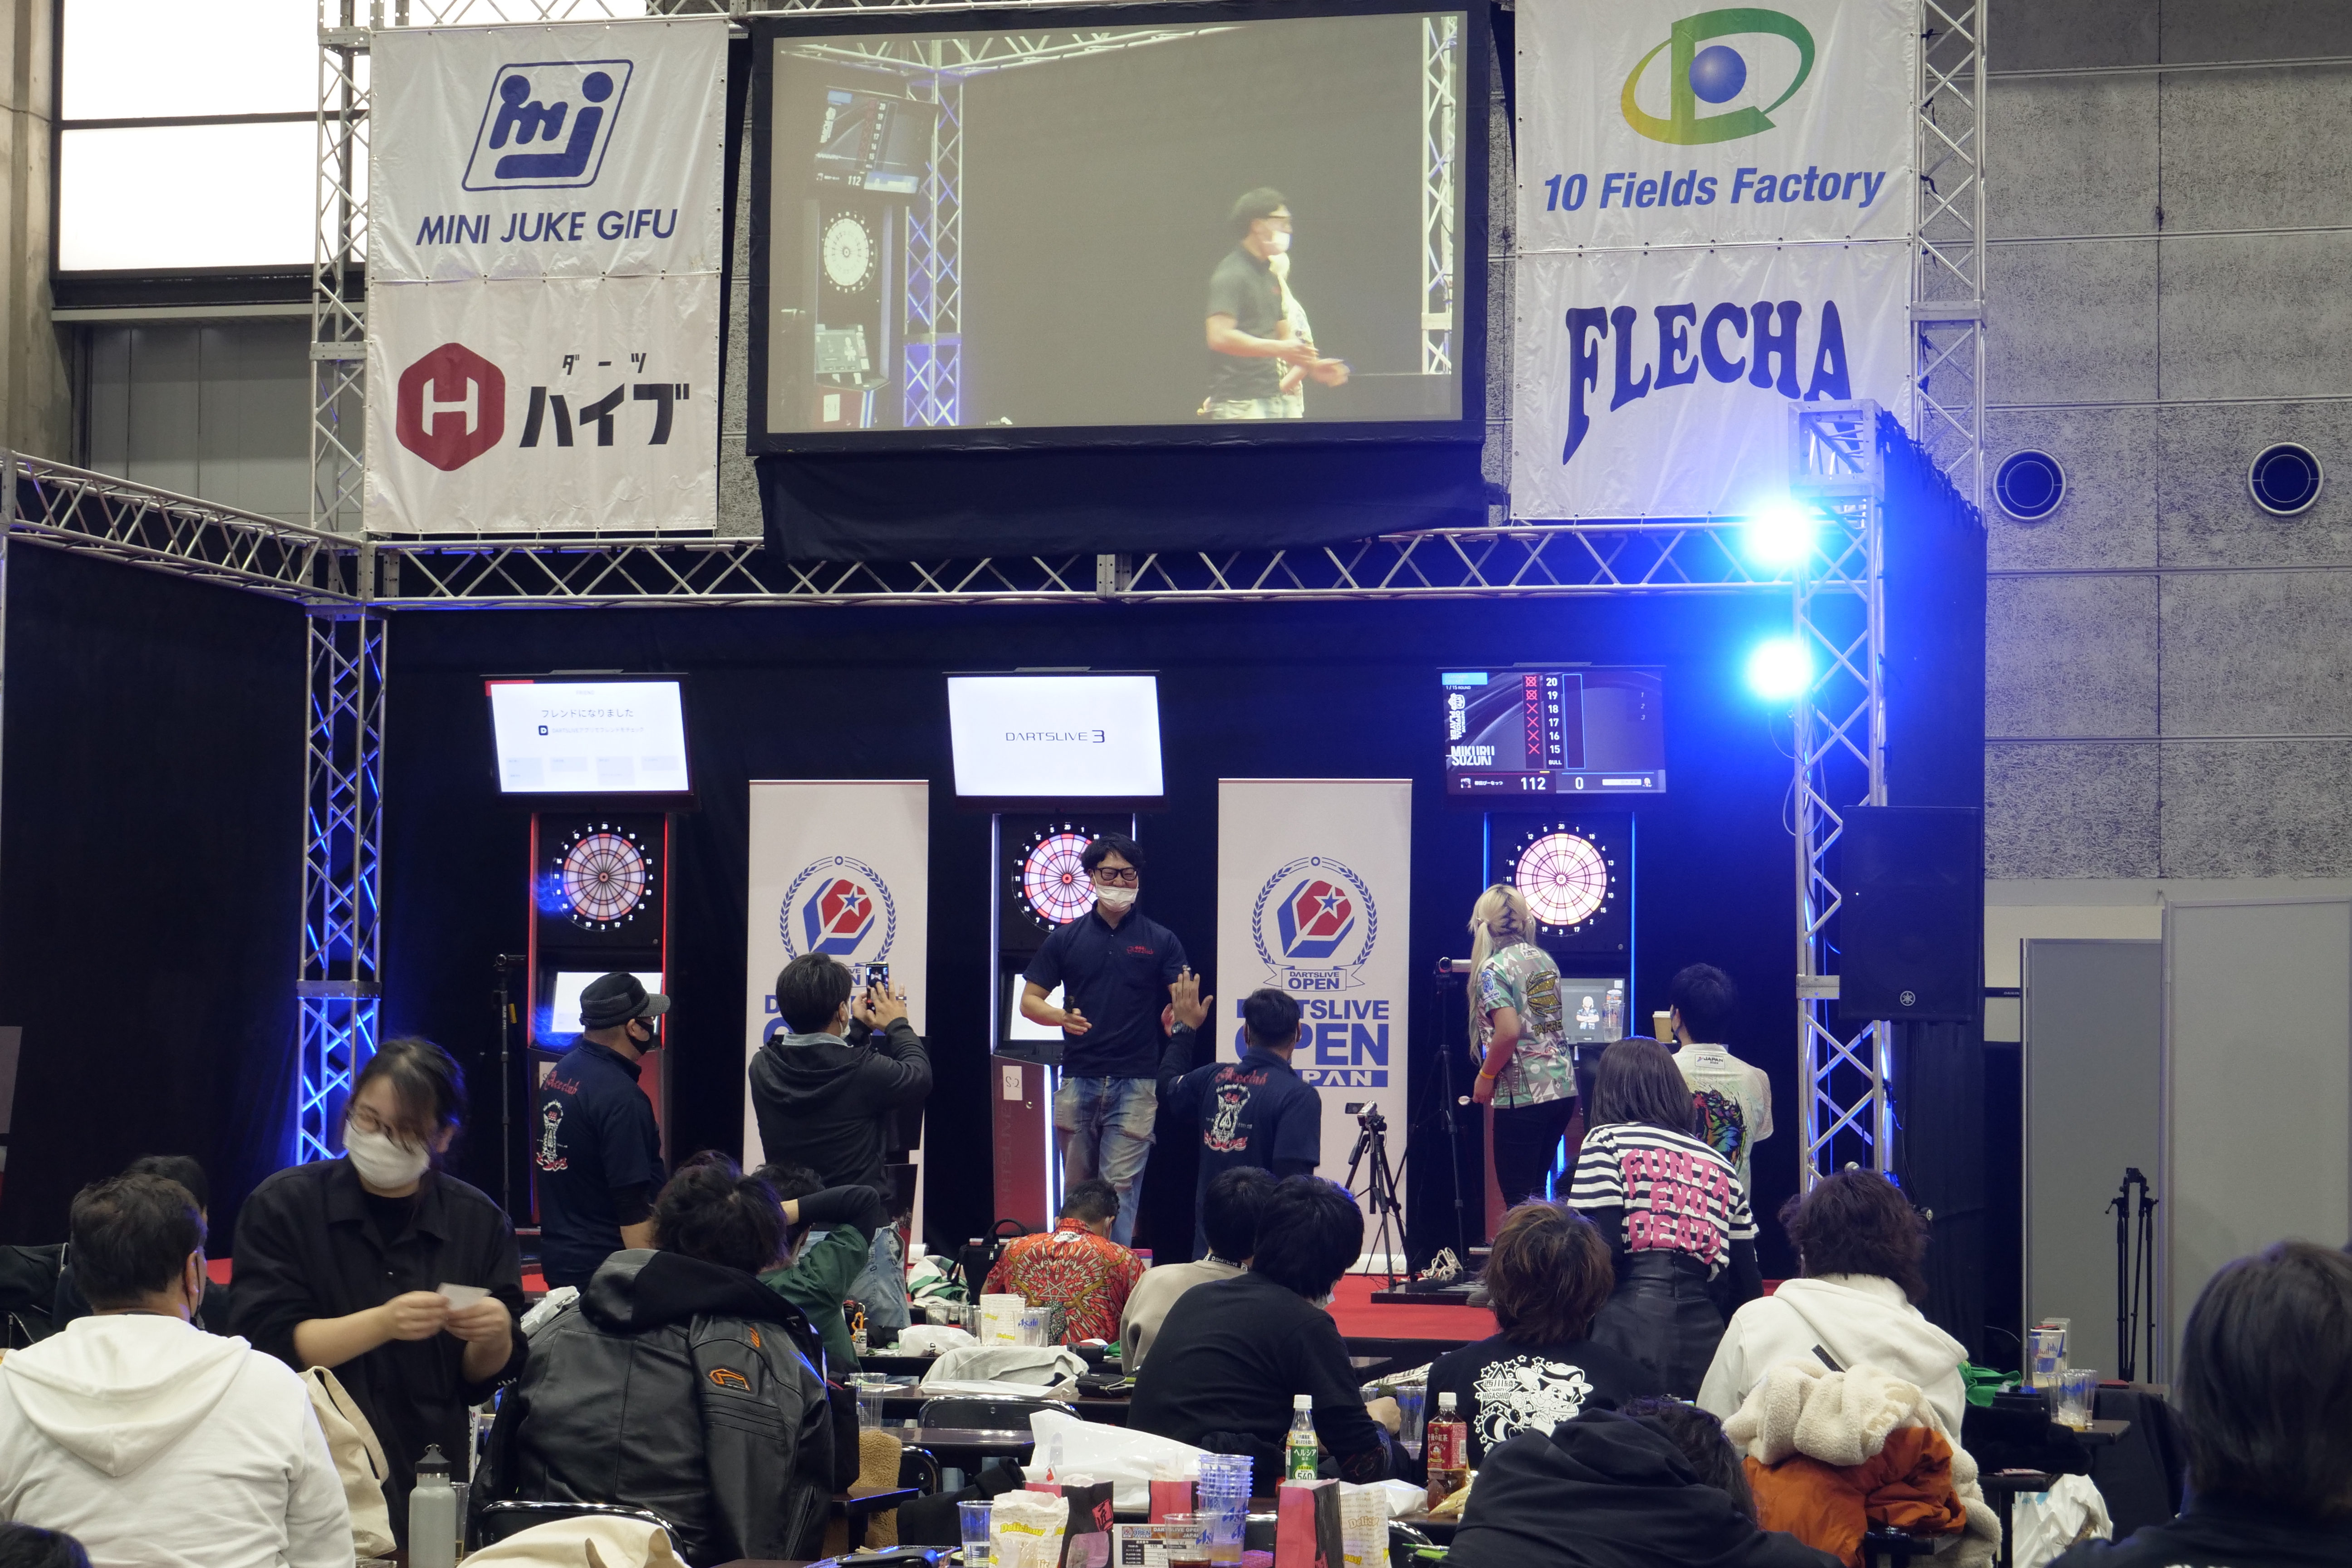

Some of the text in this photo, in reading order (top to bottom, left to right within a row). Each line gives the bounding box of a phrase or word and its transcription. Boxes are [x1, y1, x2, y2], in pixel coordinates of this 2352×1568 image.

[1544, 166, 1886, 211] 10 Fields Factory
[416, 208, 678, 246] MINI JUKE GIFU
[562, 352, 647, 375] ダーツ
[1562, 299, 1864, 466] FLECHA
[519, 382, 690, 448] ハイブ
[1546, 678, 1557, 686] 20
[1548, 691, 1558, 700] 19
[542, 708, 634, 718] フレンドになりました
[1548, 705, 1558, 713] 18
[1549, 718, 1558, 726] 17
[1006, 730, 1105, 743] DARTSLIVE 3
[1549, 732, 1559, 740] 16
[1550, 745, 1560, 753] 15
[1520, 777, 1546, 790] 112
[1575, 777, 1584, 790] 0
[1288, 977, 1340, 990] OPEN
[1236, 999, 1389, 1020] TSLIVE
[1622, 1148, 1730, 1219] FUNTA
[1649, 1181, 1708, 1218] EVO
[1628, 1210, 1721, 1265] DEATH
[1018, 1318, 1038, 1327] Asahi
